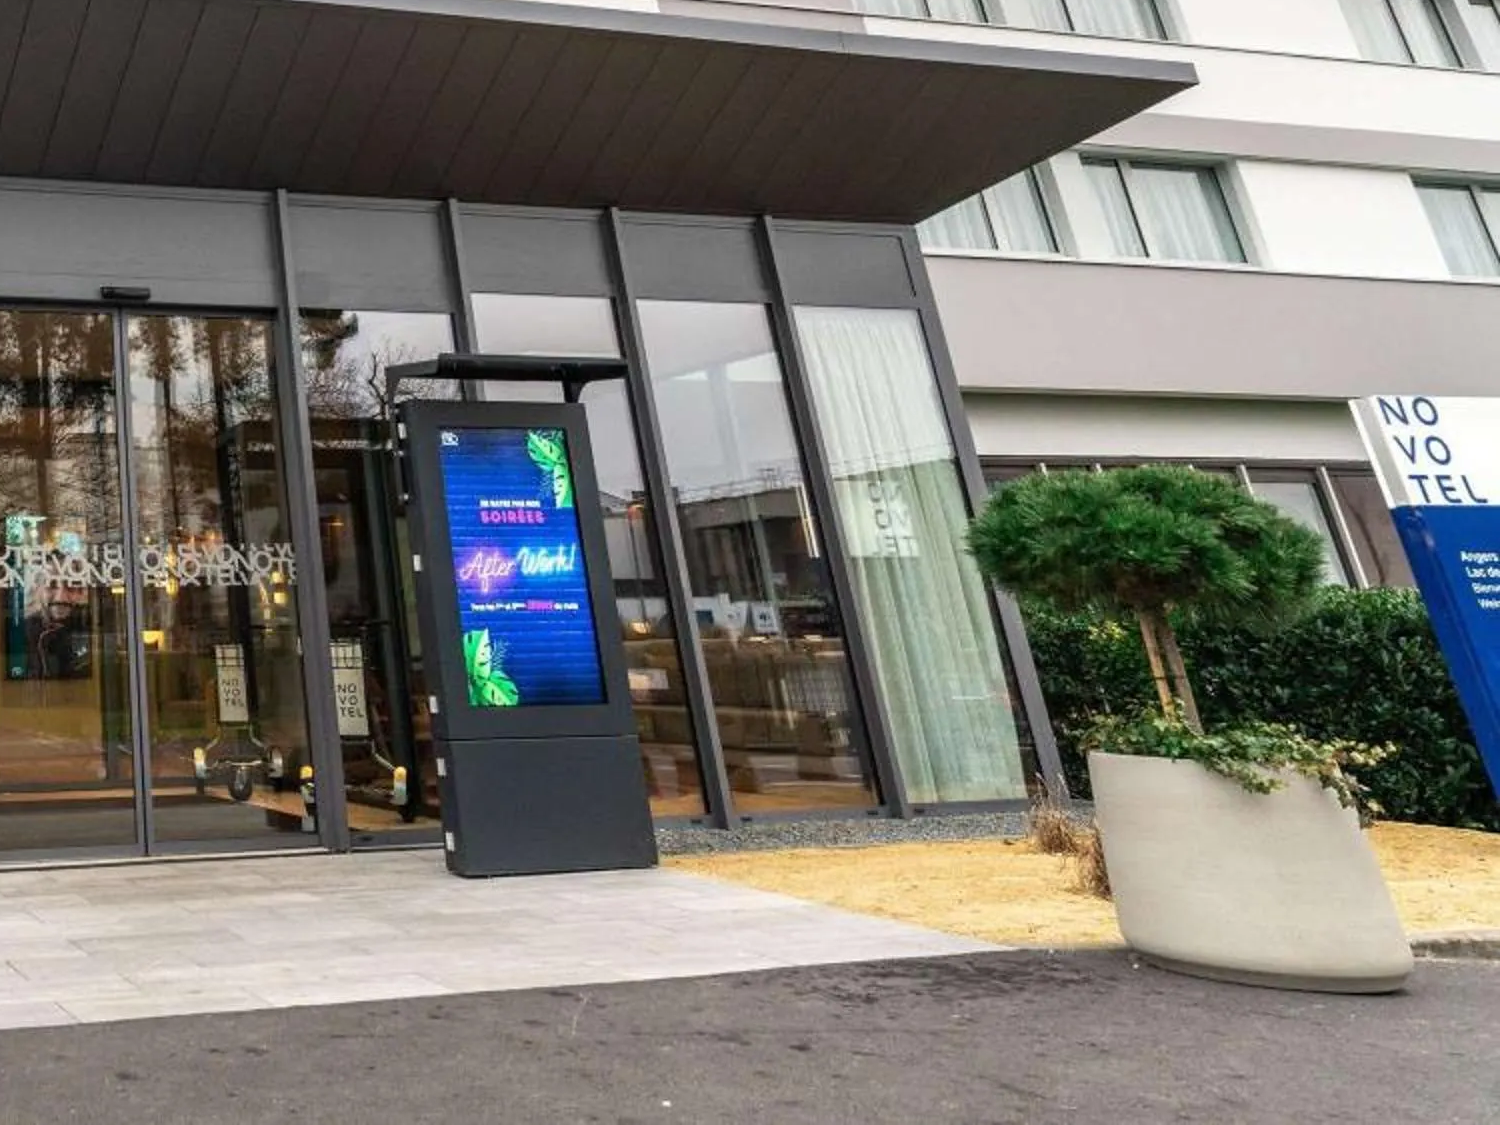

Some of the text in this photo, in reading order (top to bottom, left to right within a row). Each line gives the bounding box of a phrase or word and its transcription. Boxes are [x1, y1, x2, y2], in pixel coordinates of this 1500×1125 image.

[1376, 396, 1439, 426] NO
[1393, 435, 1452, 466] VO
[1408, 474, 1489, 504] TEL
[459, 542, 577, 593] After Work!
[337, 682, 358, 694] NO
[339, 695, 359, 706] VO
[340, 706, 364, 718] TEL
